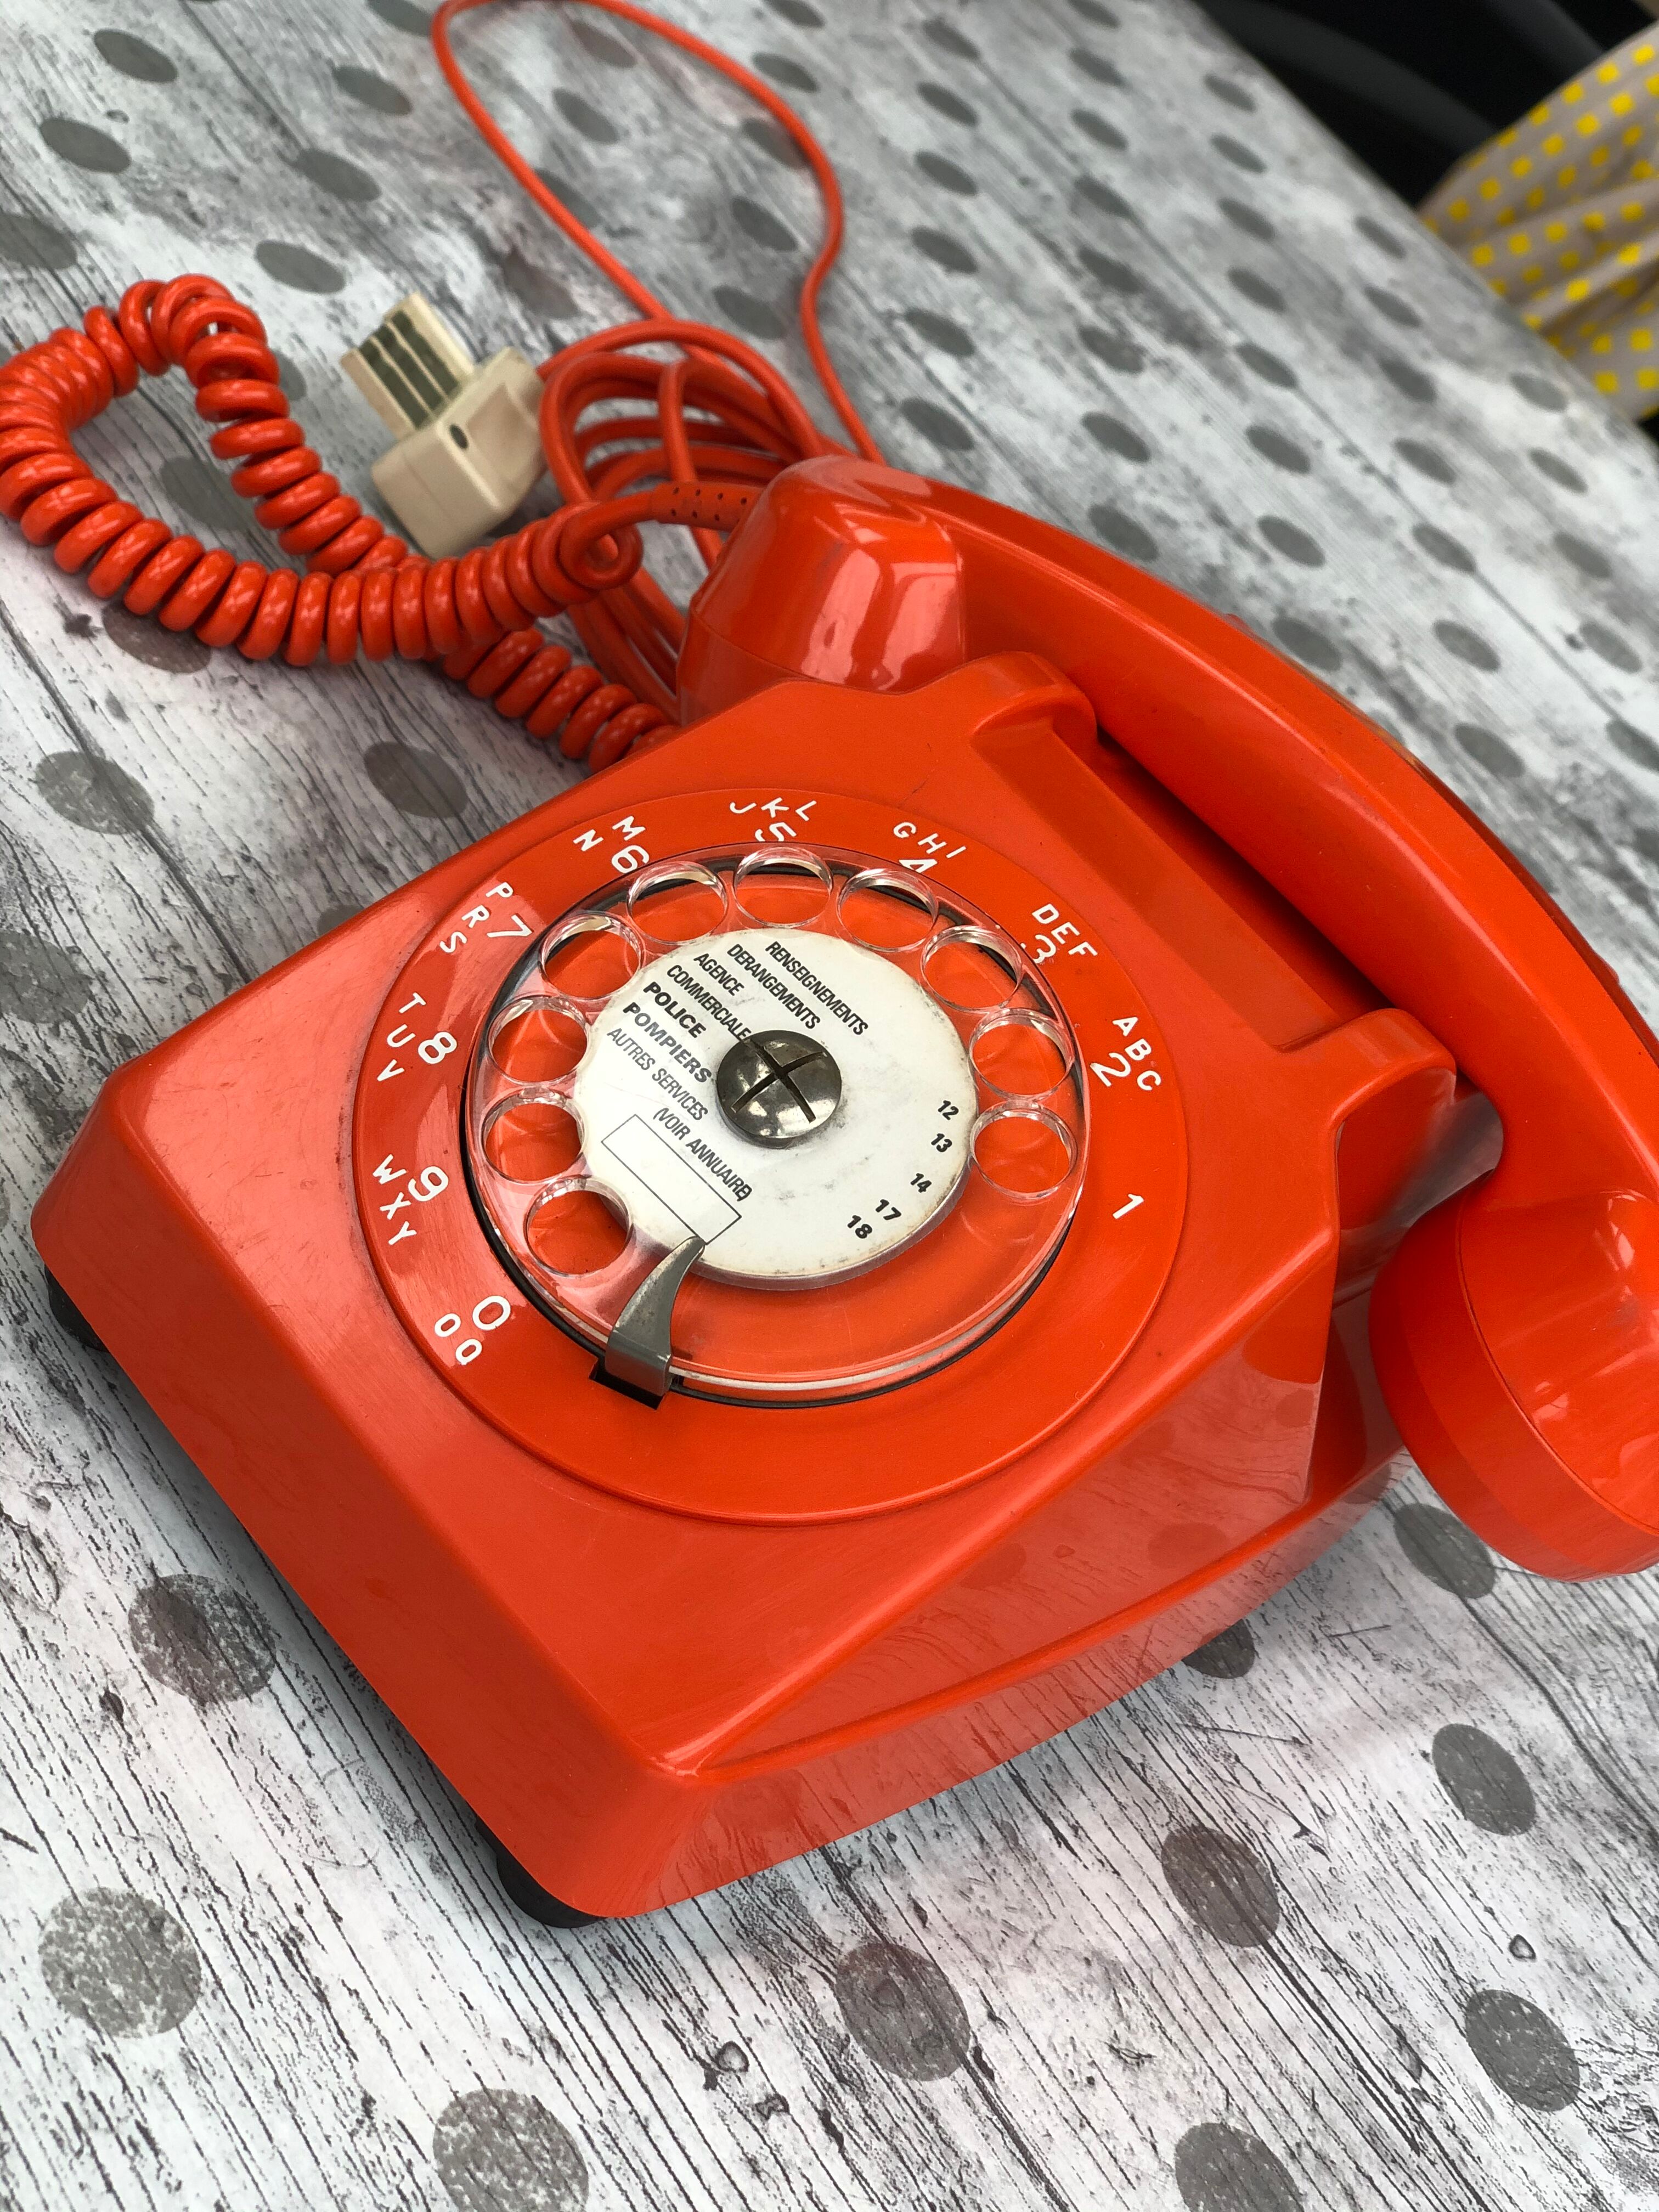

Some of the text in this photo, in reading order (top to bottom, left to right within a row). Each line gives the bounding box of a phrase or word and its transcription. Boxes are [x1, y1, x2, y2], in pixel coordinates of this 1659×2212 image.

[754, 822, 797, 842] 5
[611, 845, 650, 874] 6
[898, 859, 938, 873] 4
[487, 914, 533, 938] 7
[1020, 934, 1057, 964] 3
[693, 953, 744, 996] AGENCE
[727, 944, 821, 1029] DERANGEMENTS
[765, 941, 868, 1035] RENSEIGNEMENTS
[643, 981, 707, 1038] POLICE
[667, 964, 752, 1041] COMMERCIALE
[417, 1031, 458, 1064] 8
[623, 1002, 712, 1082] POMPIERS
[606, 1028, 709, 1121] AUTRES SERVICES
[1090, 1052, 1131, 1087] 2
[938, 1100, 959, 1120] 12
[653, 1107, 753, 1202] (VOIR ANNUAIRE)
[931, 1133, 952, 1153] 13
[408, 1166, 449, 1201] 9
[910, 1173, 932, 1193] 14
[876, 1199, 901, 1220] 17
[1113, 1194, 1144, 1219] 1
[847, 1215, 873, 1239] 18
[472, 1295, 511, 1330] 0
